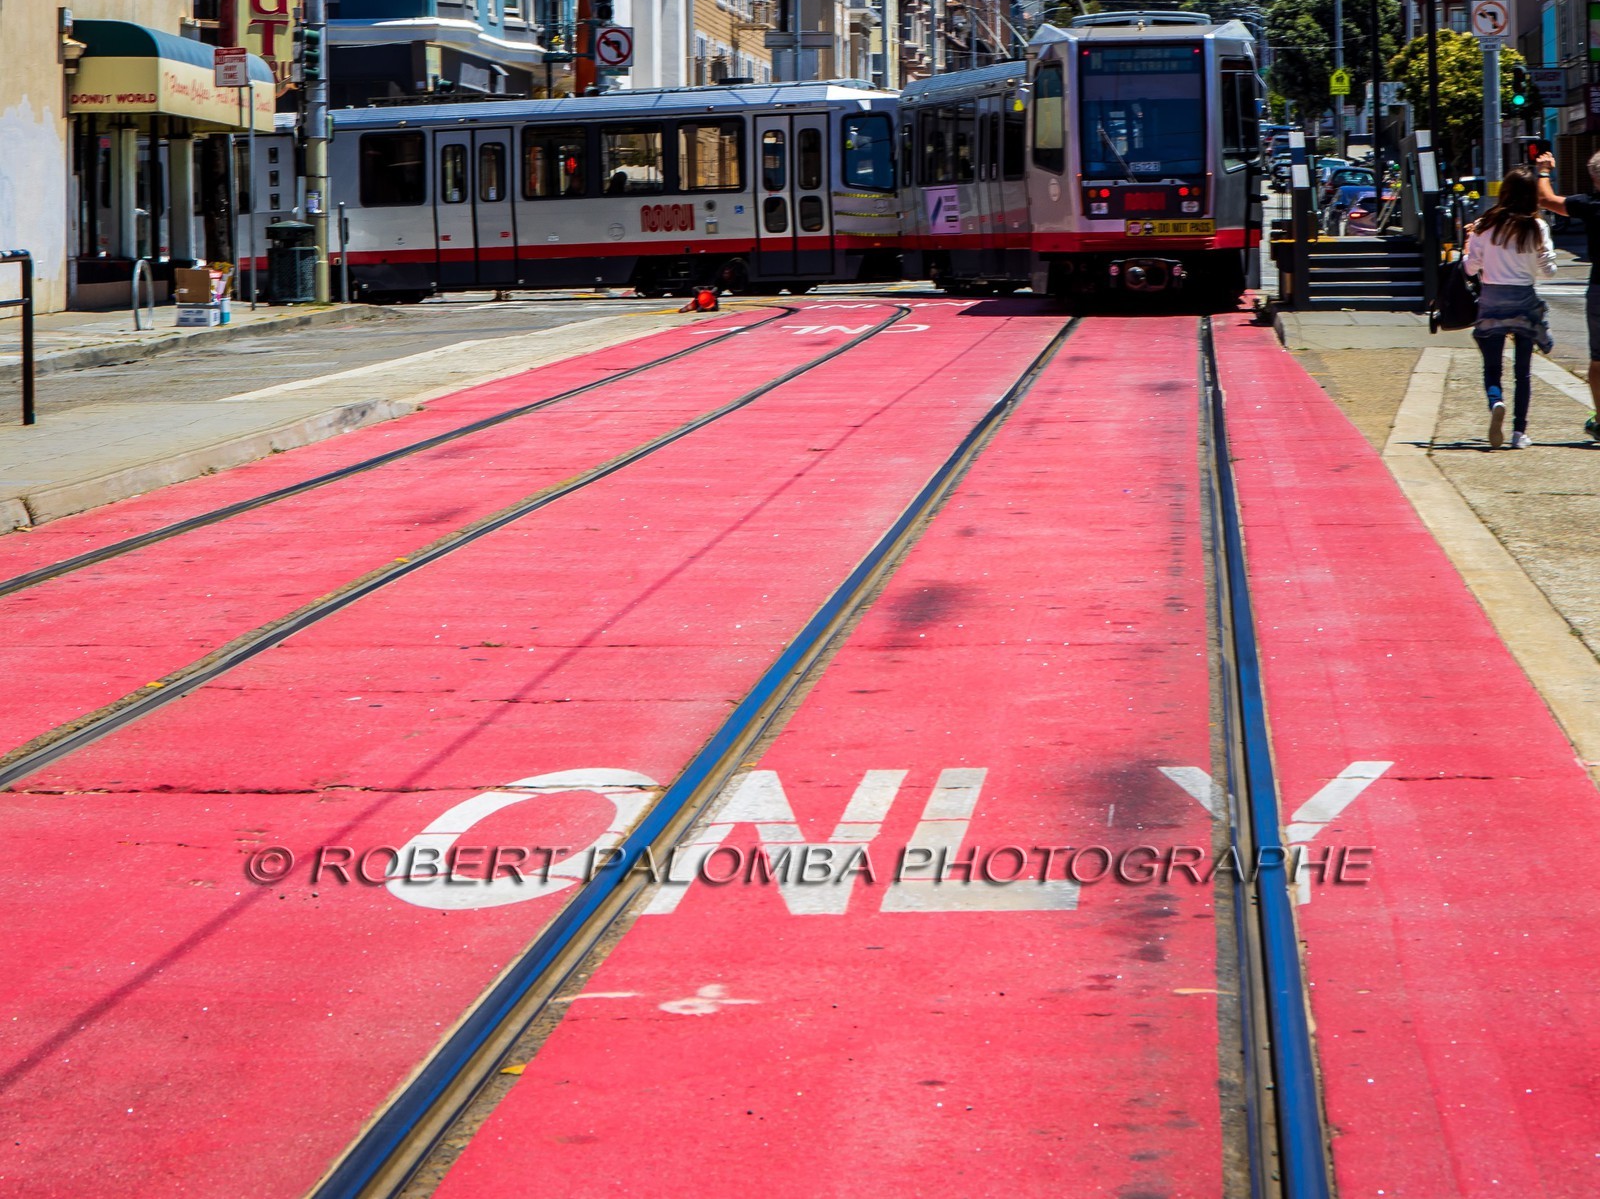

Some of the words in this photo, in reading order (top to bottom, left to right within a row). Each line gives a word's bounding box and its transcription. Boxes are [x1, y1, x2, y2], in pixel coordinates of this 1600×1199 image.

[70, 93, 112, 104] DONUT
[116, 92, 157, 104] WORLD
[384, 760, 1394, 912] ONLY
